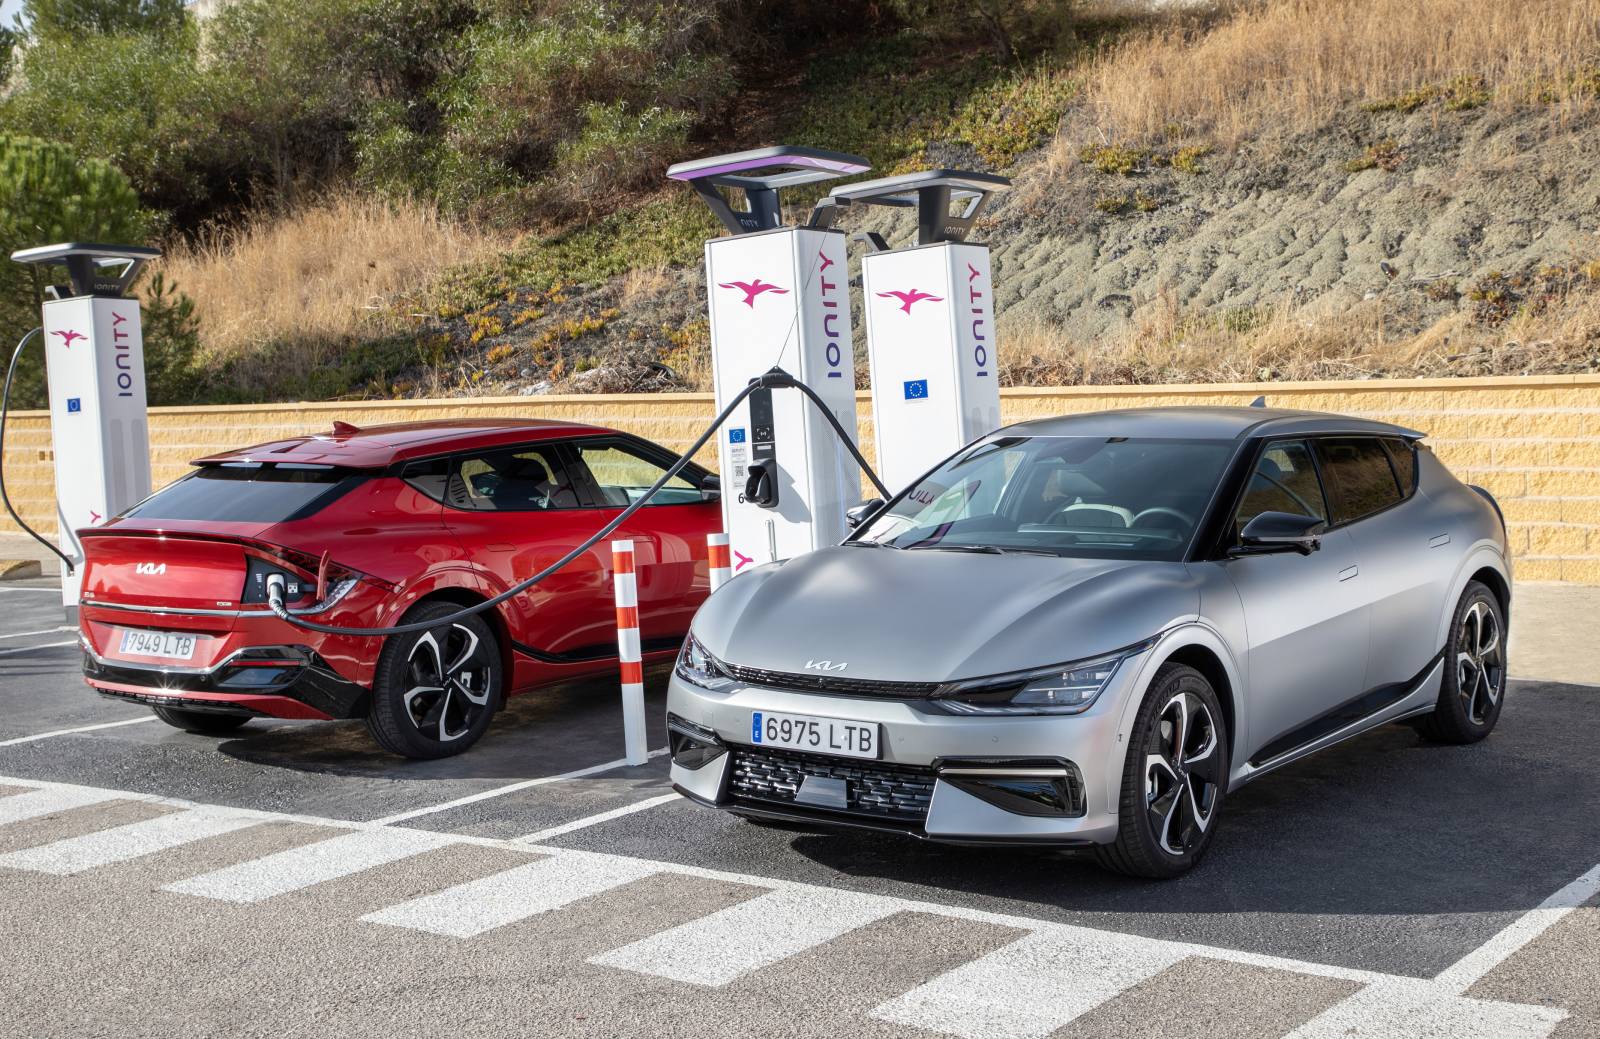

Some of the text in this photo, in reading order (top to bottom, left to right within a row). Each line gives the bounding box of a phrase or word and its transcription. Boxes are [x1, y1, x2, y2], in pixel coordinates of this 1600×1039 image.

[738, 492, 745, 504] 6
[135, 562, 167, 575] KIA
[129, 633, 192, 656] 7949 LTB
[805, 658, 848, 671] KIA
[766, 717, 872, 752] 6975 LTB
